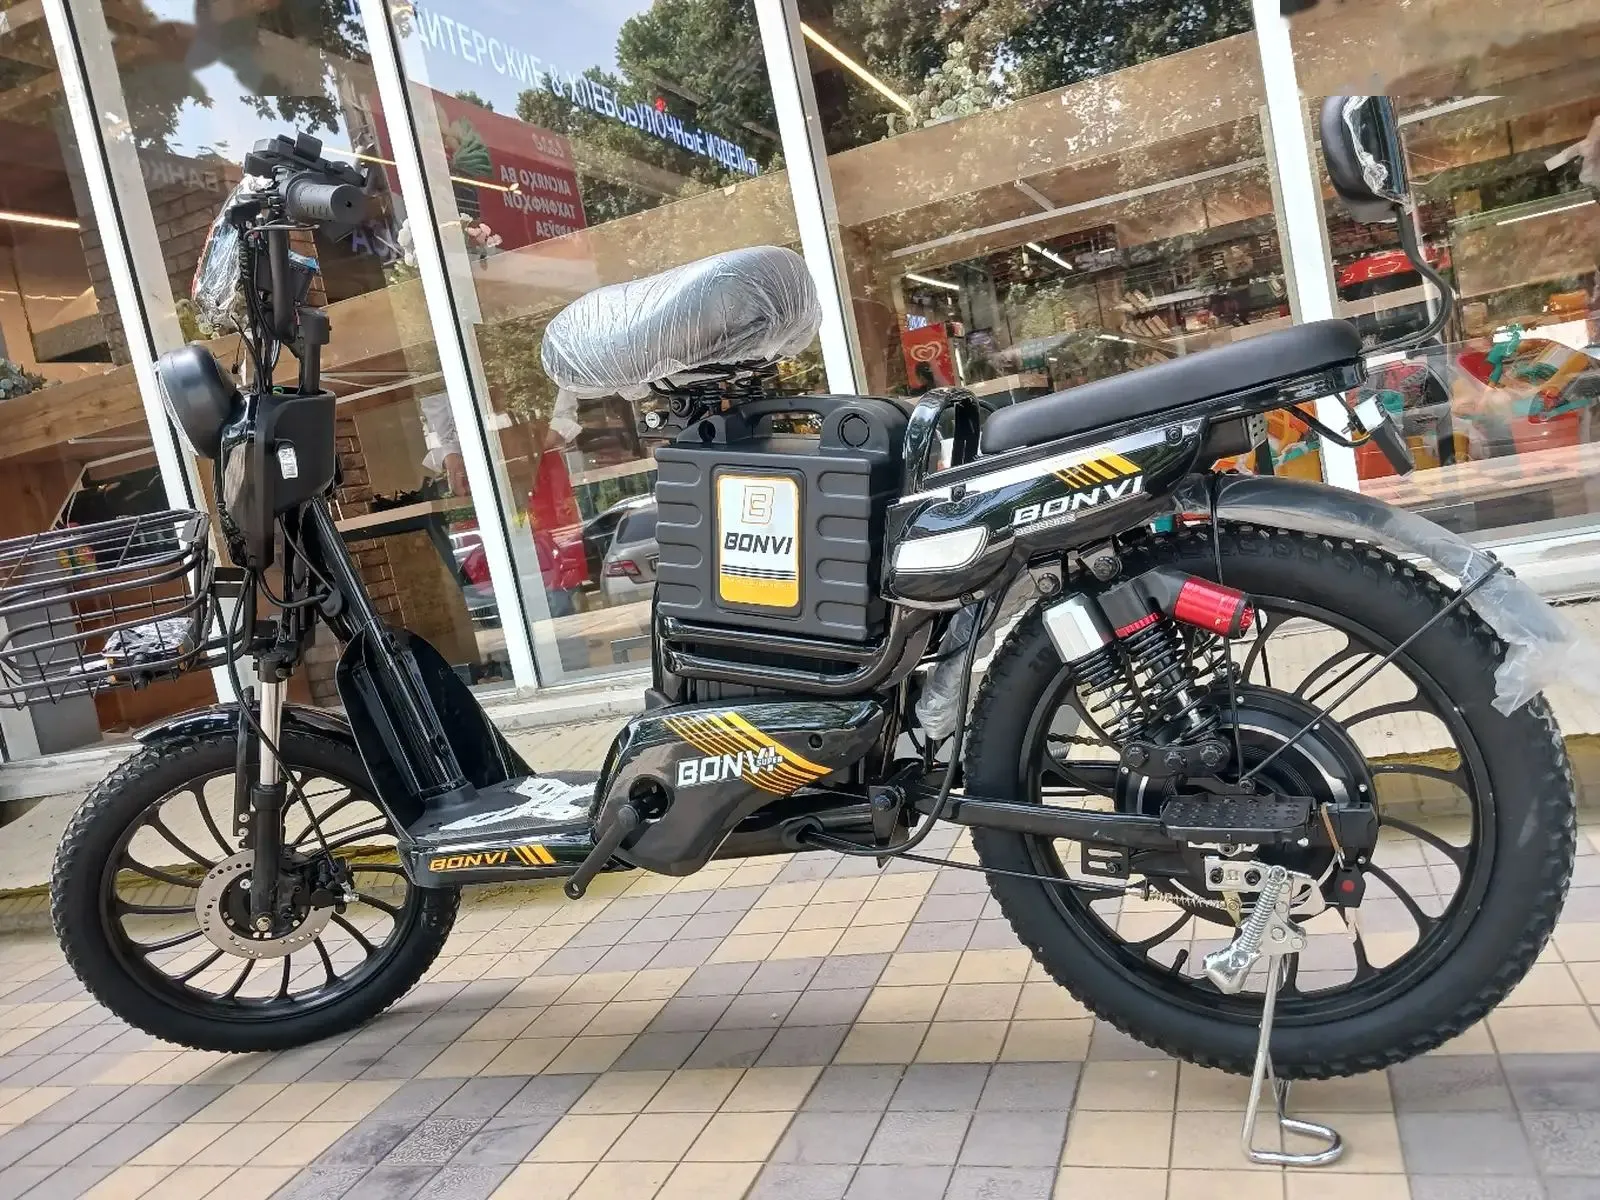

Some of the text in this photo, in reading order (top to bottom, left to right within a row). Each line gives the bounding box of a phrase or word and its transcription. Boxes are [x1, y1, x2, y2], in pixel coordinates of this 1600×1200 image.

[1012, 475, 1144, 527] BONVI
[724, 532, 793, 555] BONVI
[677, 746, 775, 787] BONVI
[755, 755, 784, 767] SUPER
[428, 851, 509, 873] BONVI
